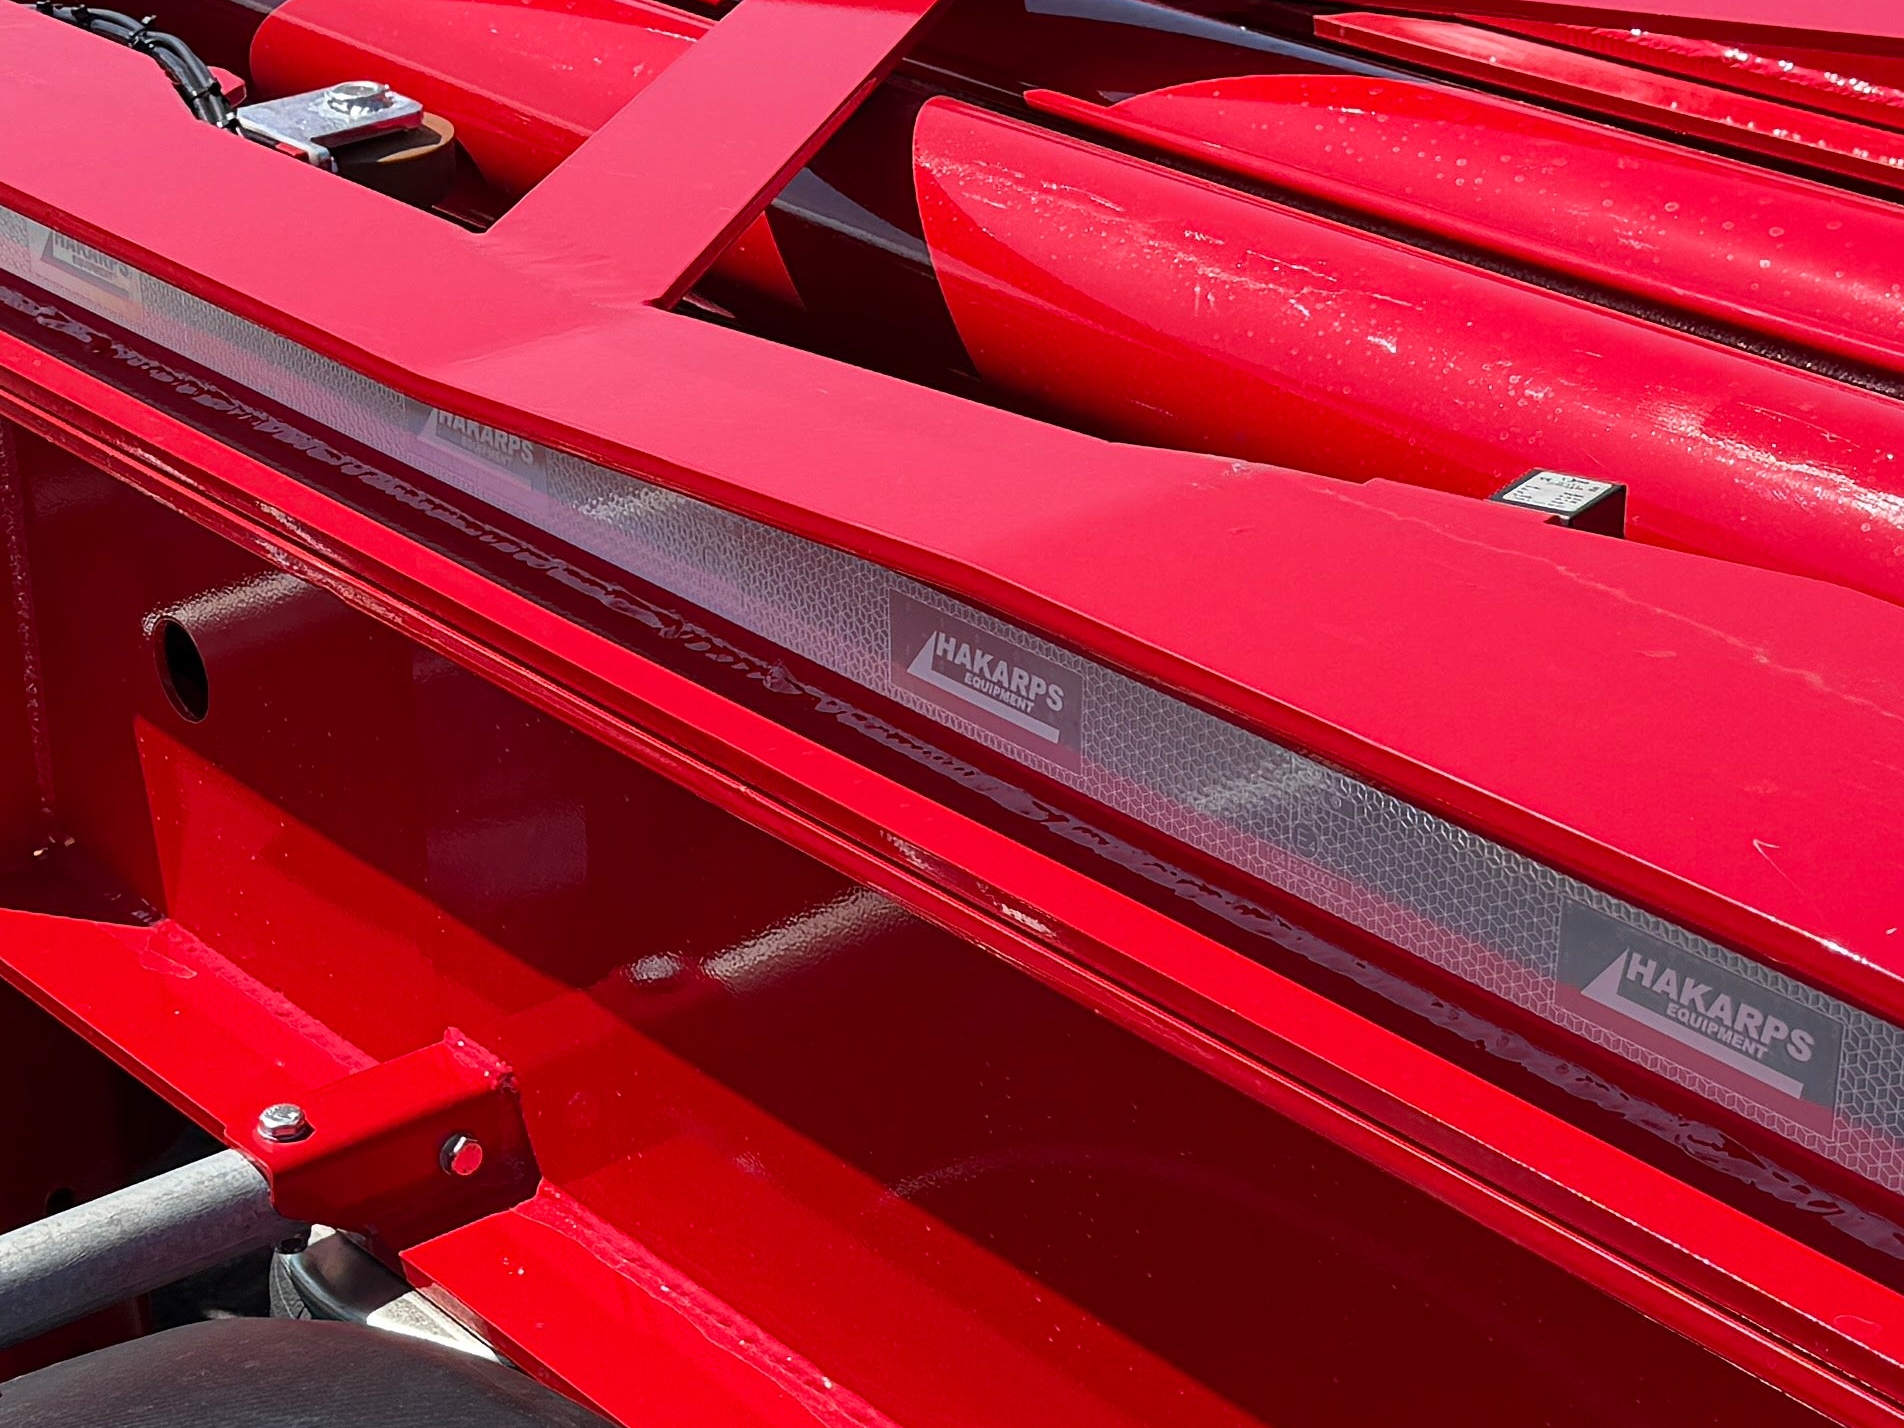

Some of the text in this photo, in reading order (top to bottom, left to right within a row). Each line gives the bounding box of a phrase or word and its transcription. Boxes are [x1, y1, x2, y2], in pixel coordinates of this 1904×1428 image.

[935, 631, 1064, 713] HAKARPS
[964, 672, 1035, 714] EQUIPMENT
[1626, 951, 1816, 1063] HAKARPS
[1665, 1002, 1770, 1060] EQUIPMENT
